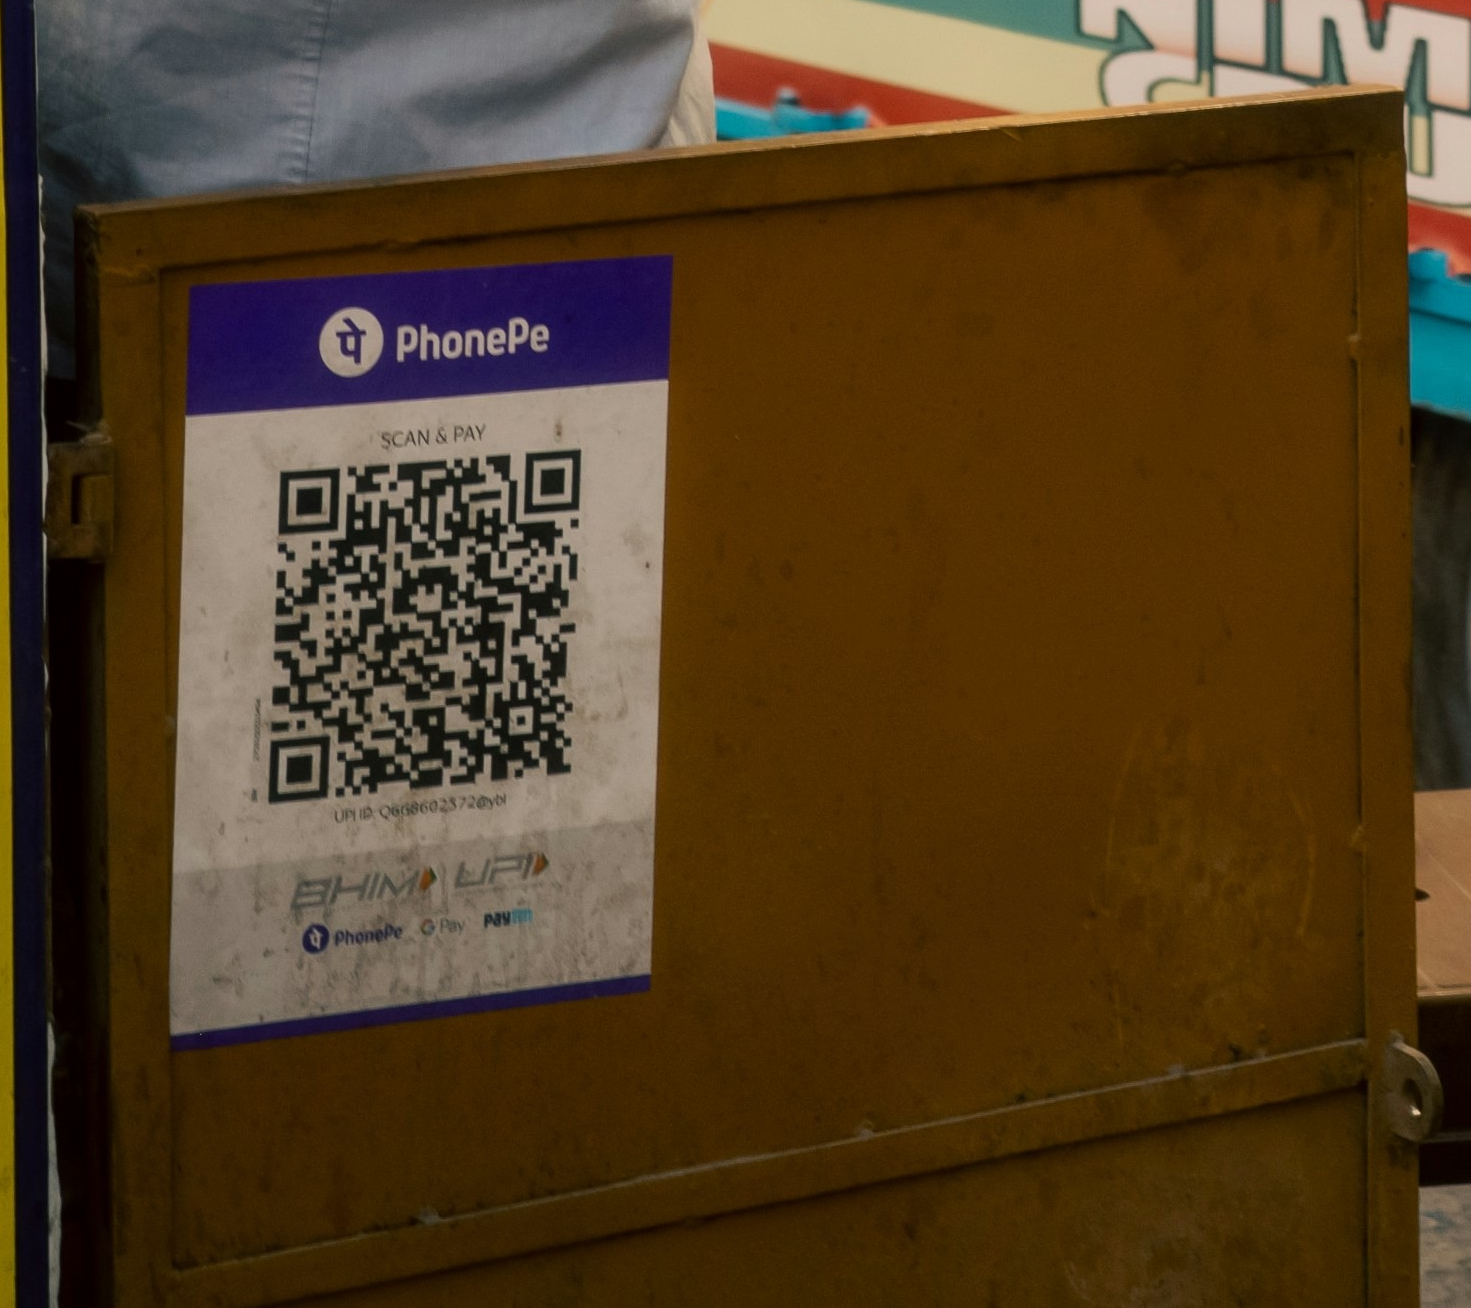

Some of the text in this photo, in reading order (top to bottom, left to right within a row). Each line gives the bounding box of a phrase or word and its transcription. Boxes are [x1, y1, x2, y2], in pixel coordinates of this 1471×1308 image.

[396, 317, 550, 364] PhonePe
[379, 423, 487, 450] SCAN & PAY
[291, 852, 533, 911] BHIM UPI
[333, 923, 403, 947] PhonePe
[440, 917, 466, 935] Pay
